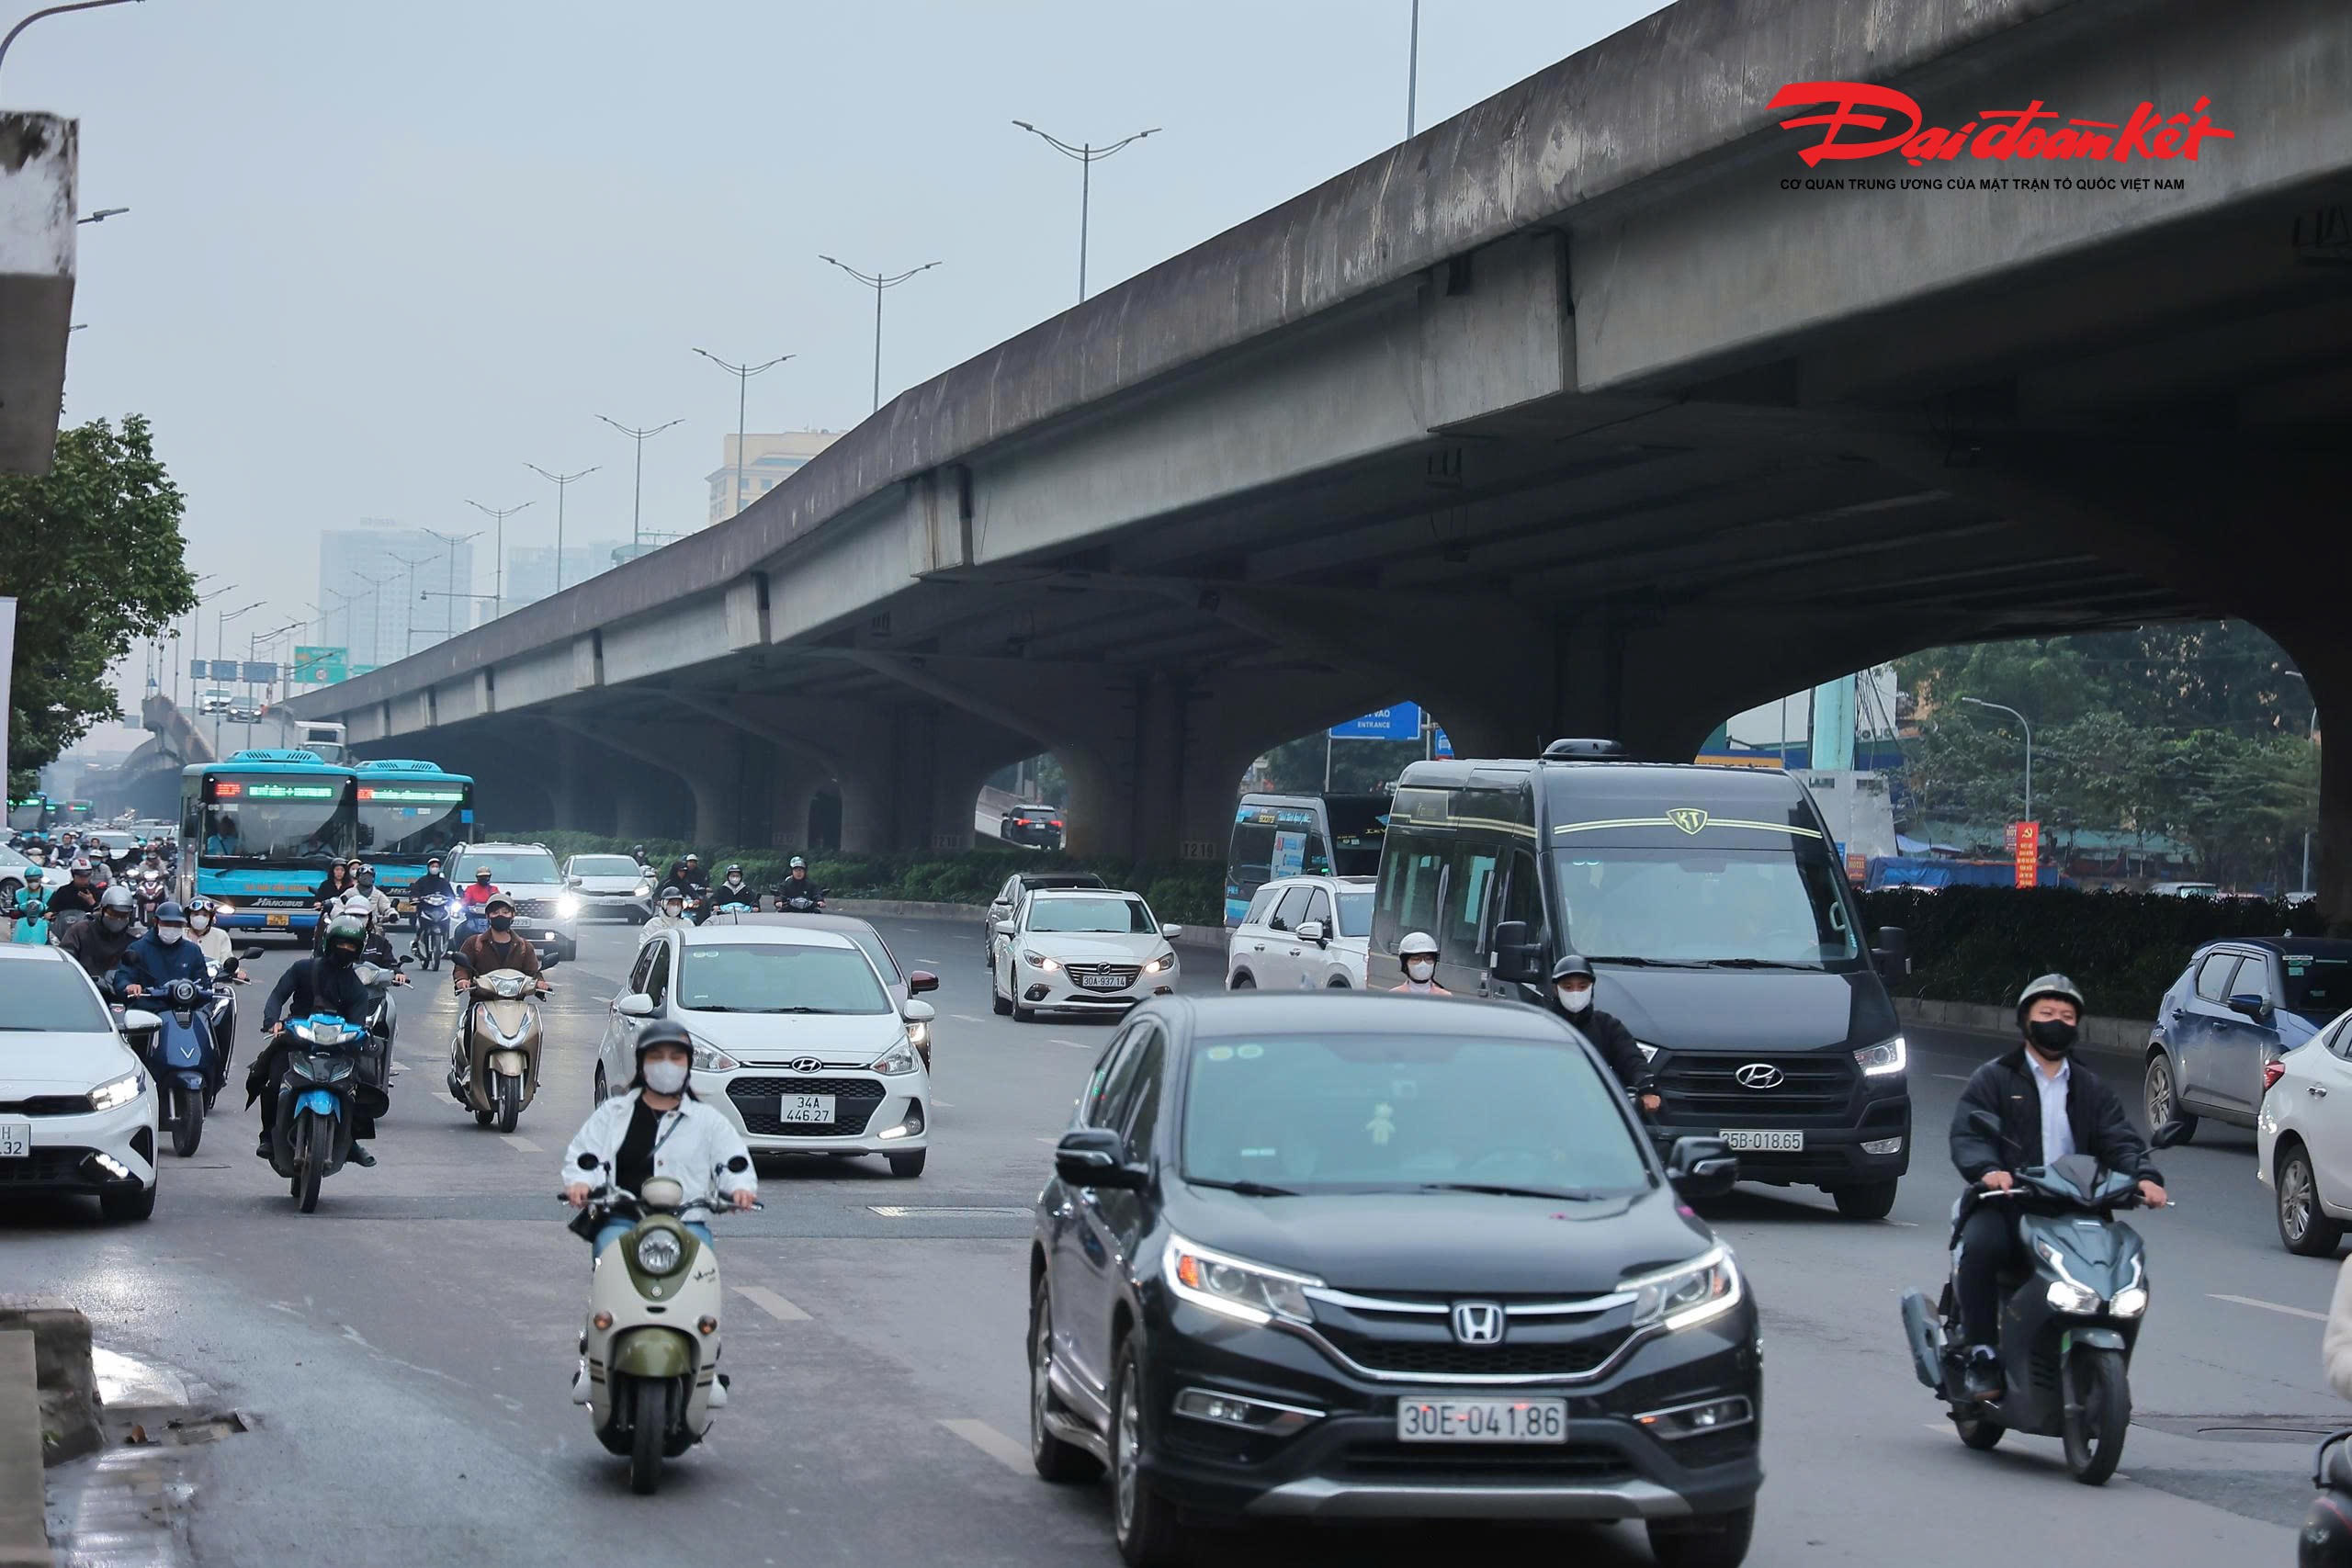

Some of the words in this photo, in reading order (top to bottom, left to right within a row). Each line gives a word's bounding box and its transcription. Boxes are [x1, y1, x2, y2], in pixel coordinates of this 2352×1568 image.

[1675, 811, 1699, 830] KT
[797, 1097, 820, 1108] 34A
[786, 1110, 829, 1122] 446.27
[1405, 1405, 1560, 1436] 30E-041.86
